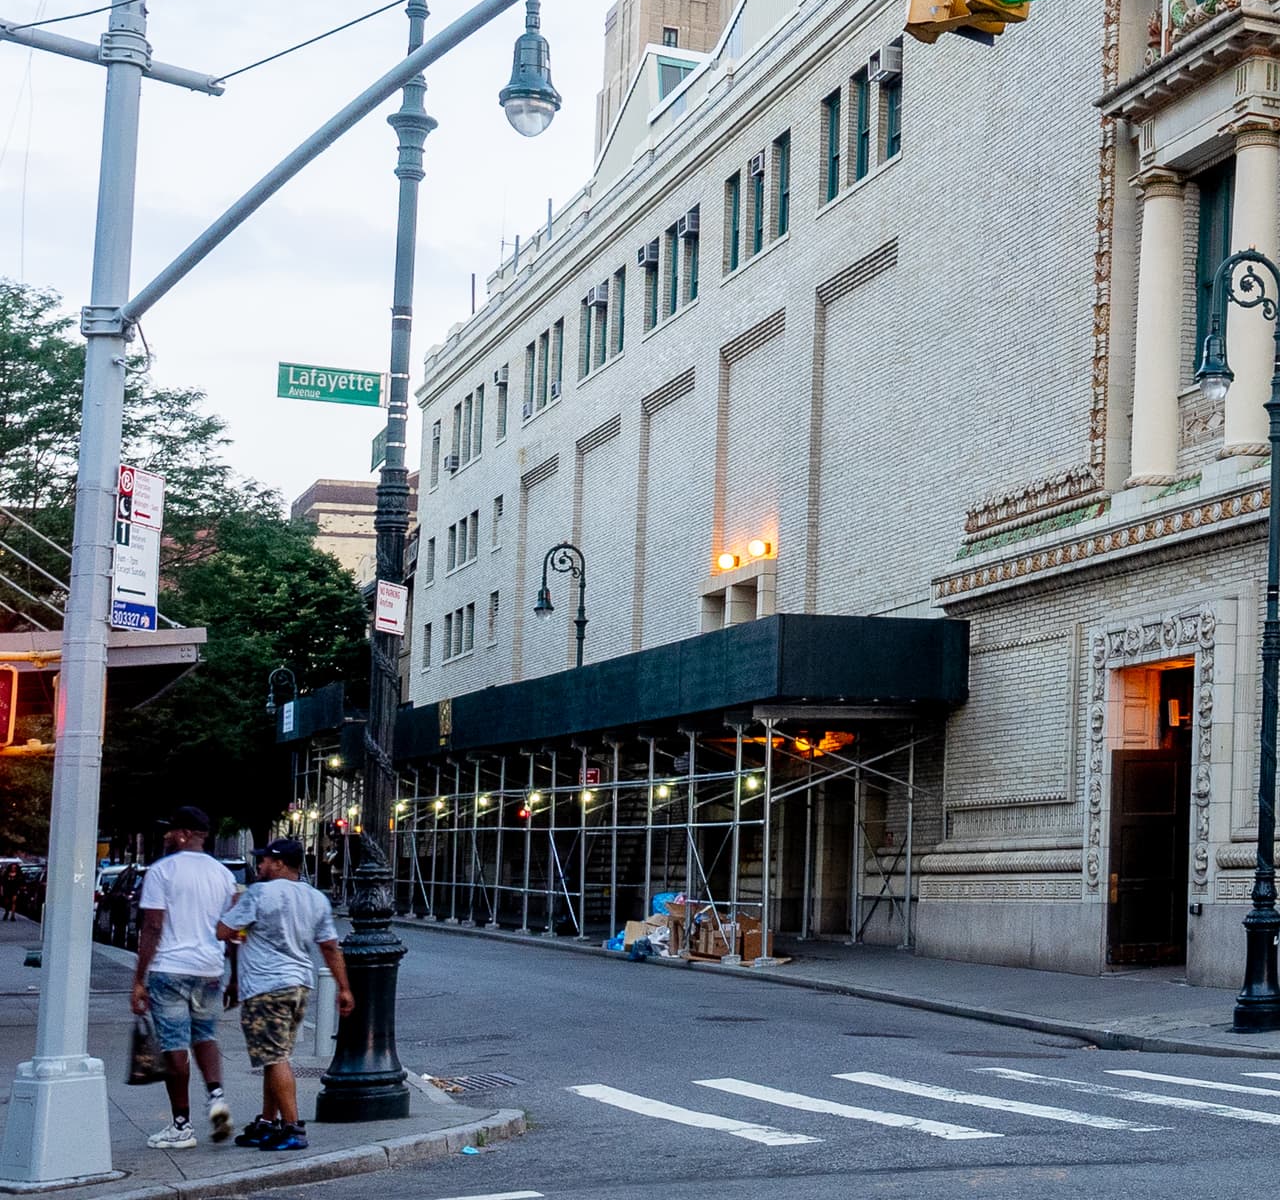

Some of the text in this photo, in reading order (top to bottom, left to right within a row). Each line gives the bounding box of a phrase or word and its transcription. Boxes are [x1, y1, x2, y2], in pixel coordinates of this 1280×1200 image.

[289, 367, 374, 392] Lafayette
[289, 386, 321, 398] Avenue
[113, 610, 140, 626] 303327
